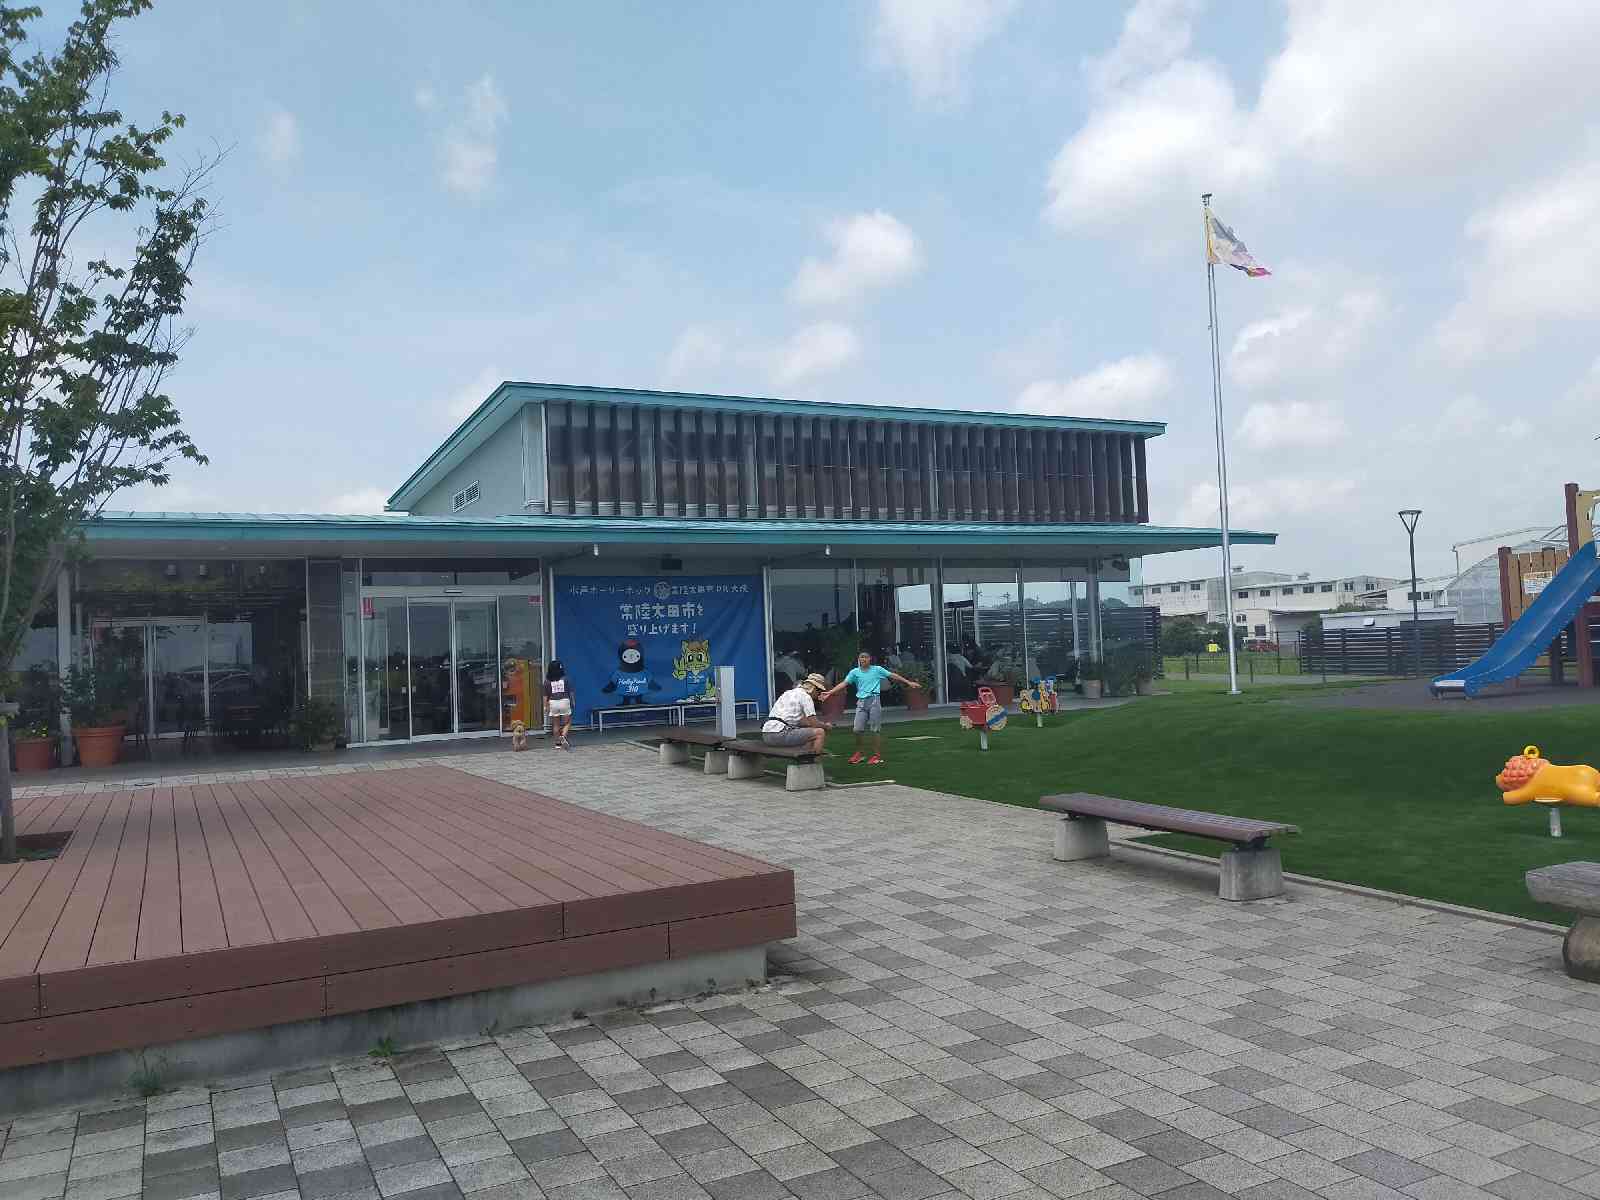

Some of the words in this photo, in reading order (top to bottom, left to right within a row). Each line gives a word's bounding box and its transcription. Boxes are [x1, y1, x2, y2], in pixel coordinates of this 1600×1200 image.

[619, 602, 704, 620] 常陸太田市を
